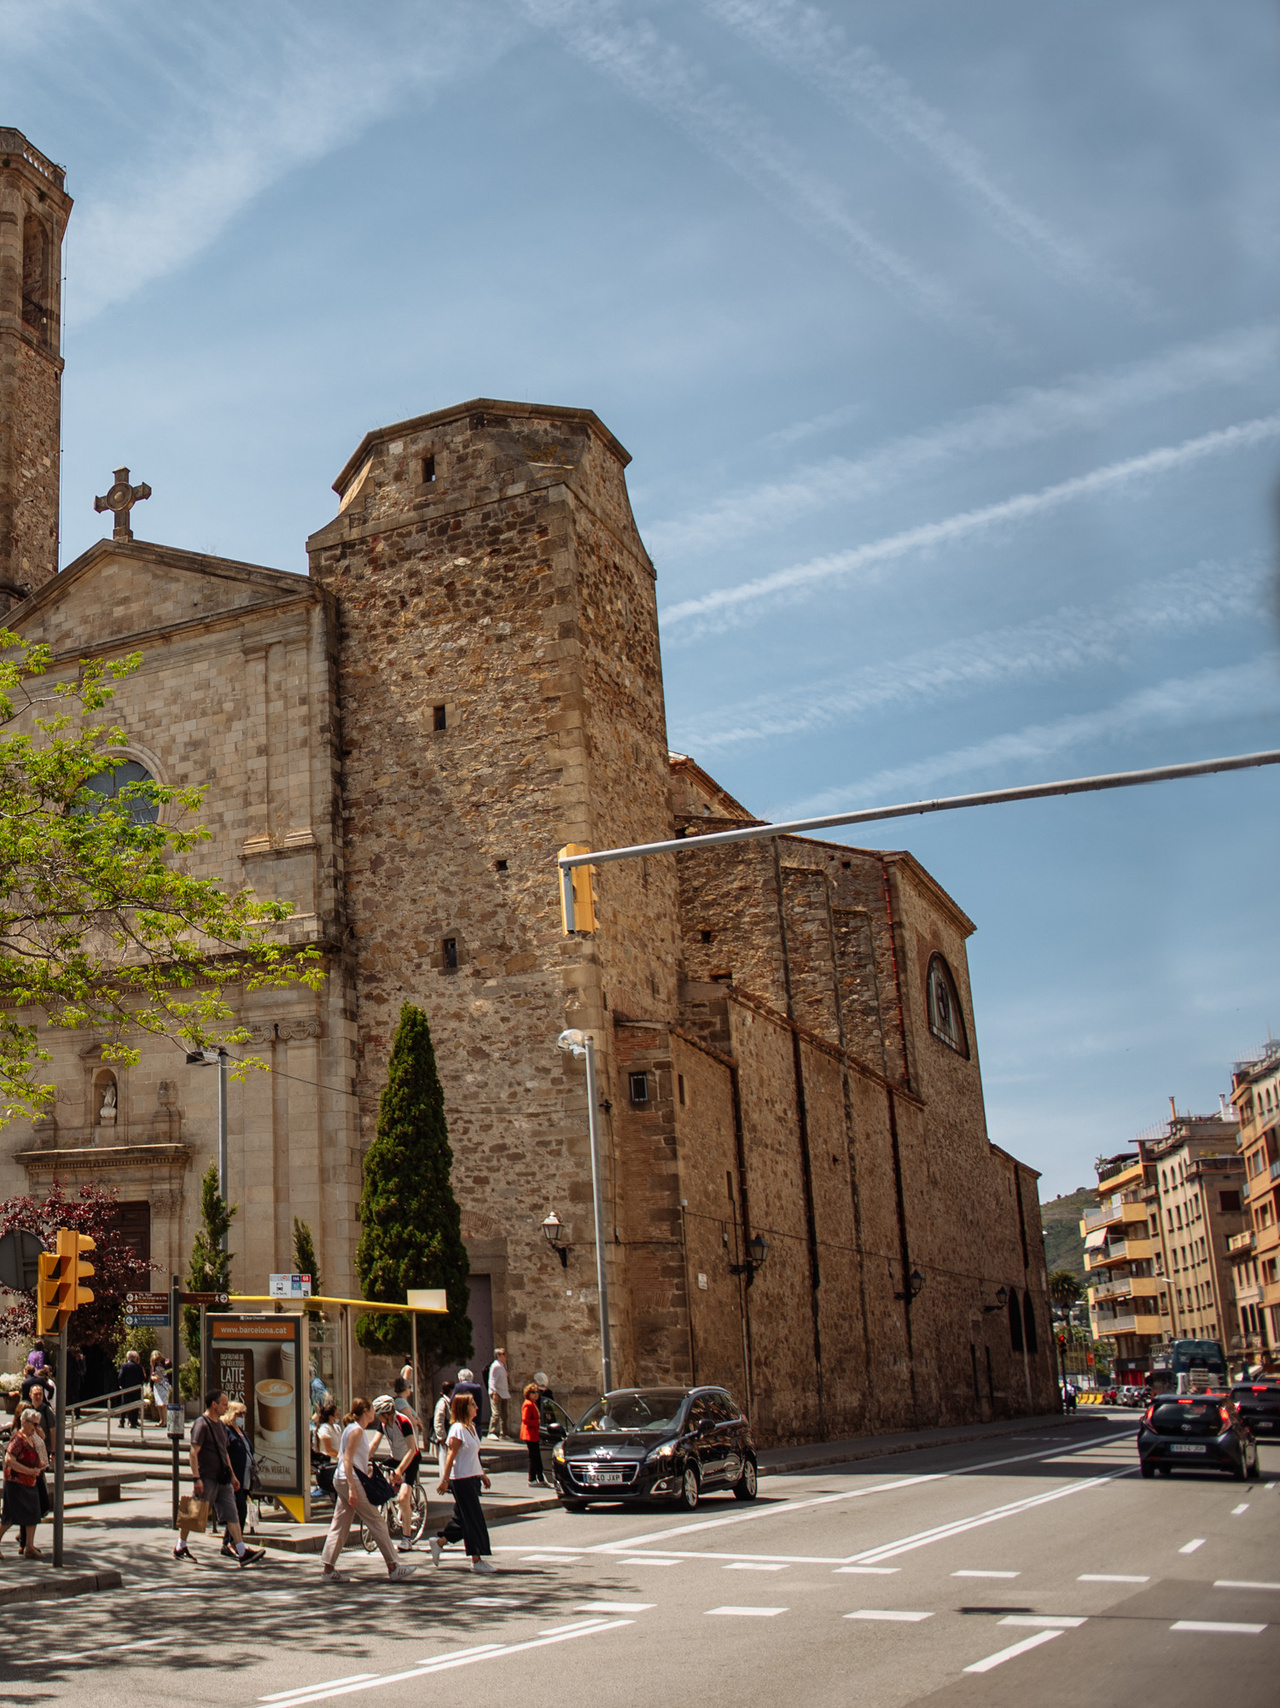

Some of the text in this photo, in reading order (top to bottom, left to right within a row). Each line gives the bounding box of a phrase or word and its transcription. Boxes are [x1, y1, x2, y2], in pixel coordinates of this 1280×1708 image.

[221, 1326, 287, 1334] www.barcelona.cat
[220, 1367, 245, 1383] LATTE
[235, 1383, 245, 1391] LAS
